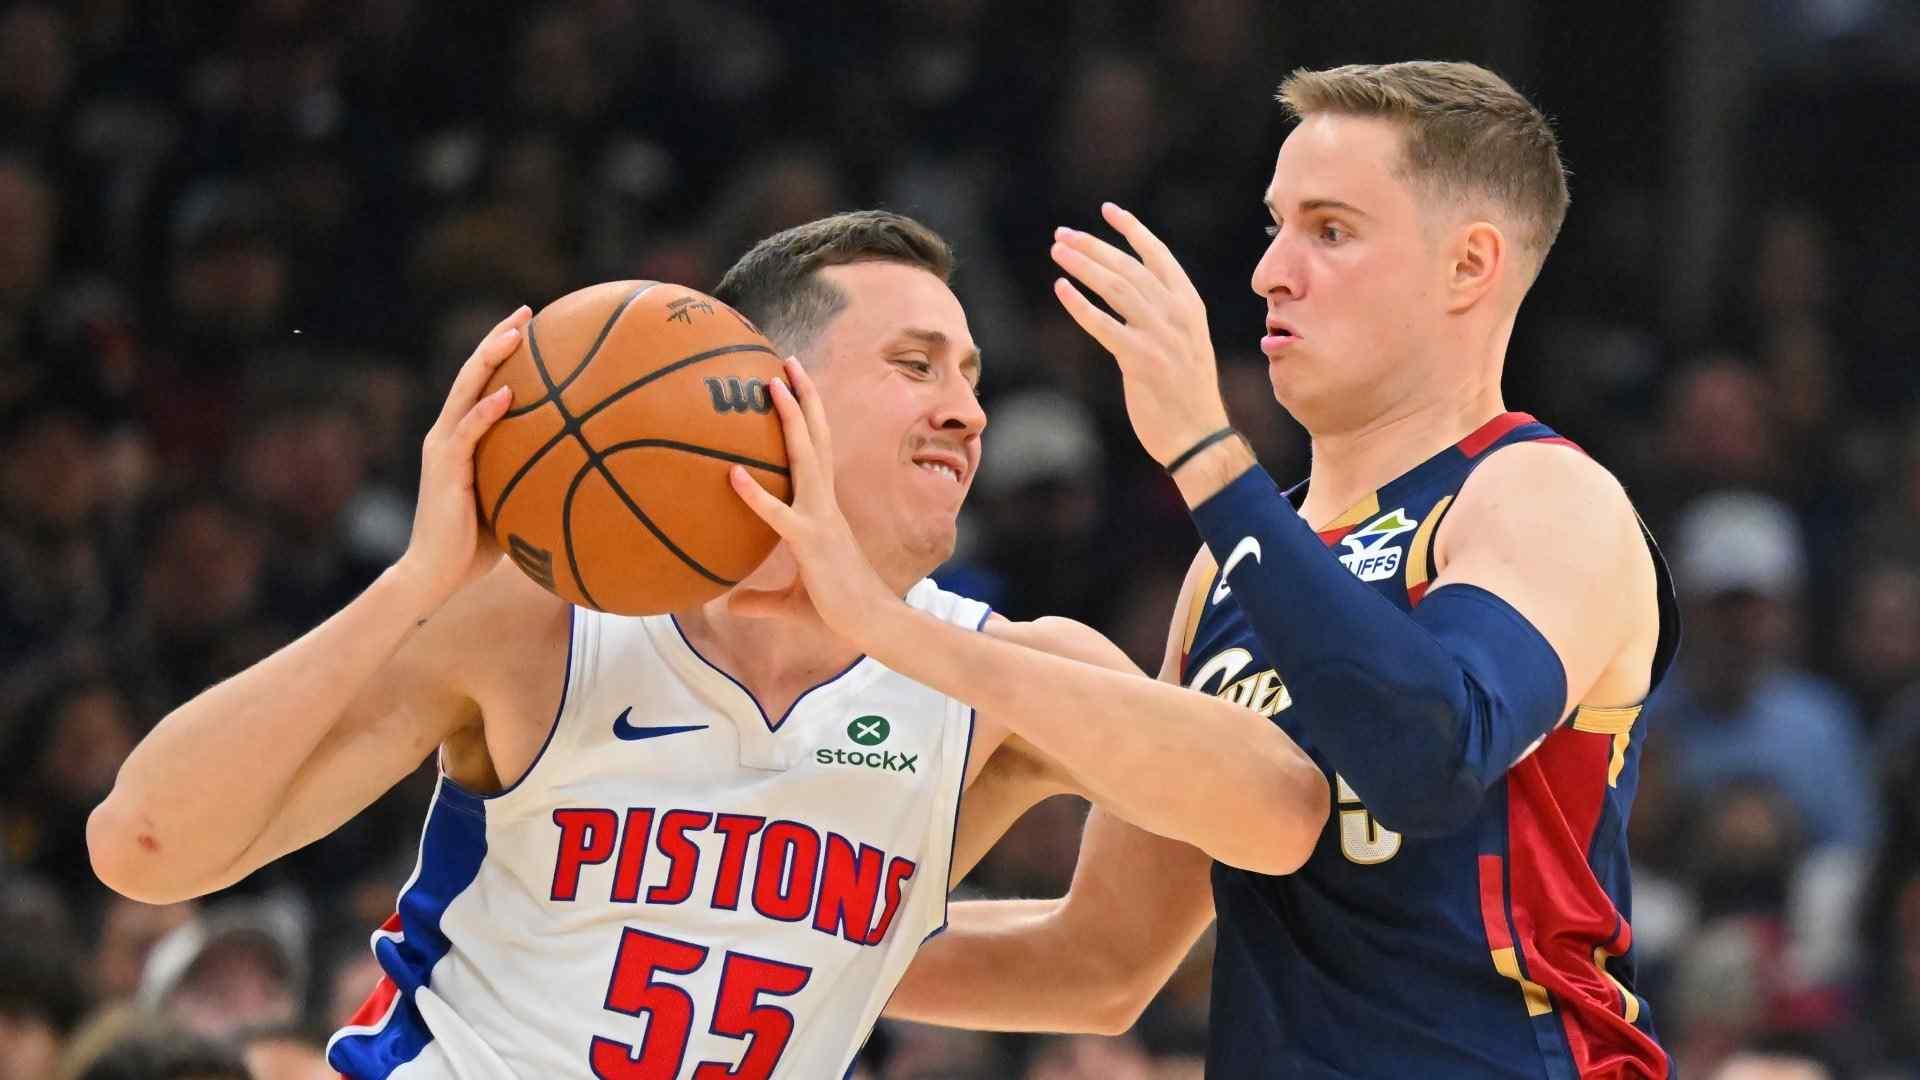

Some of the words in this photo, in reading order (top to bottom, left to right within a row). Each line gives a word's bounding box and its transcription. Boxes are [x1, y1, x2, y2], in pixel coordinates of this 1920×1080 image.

[1344, 553, 1398, 576] IFFS
[550, 807, 917, 947] PISTONS
[589, 926, 813, 1080] 55
